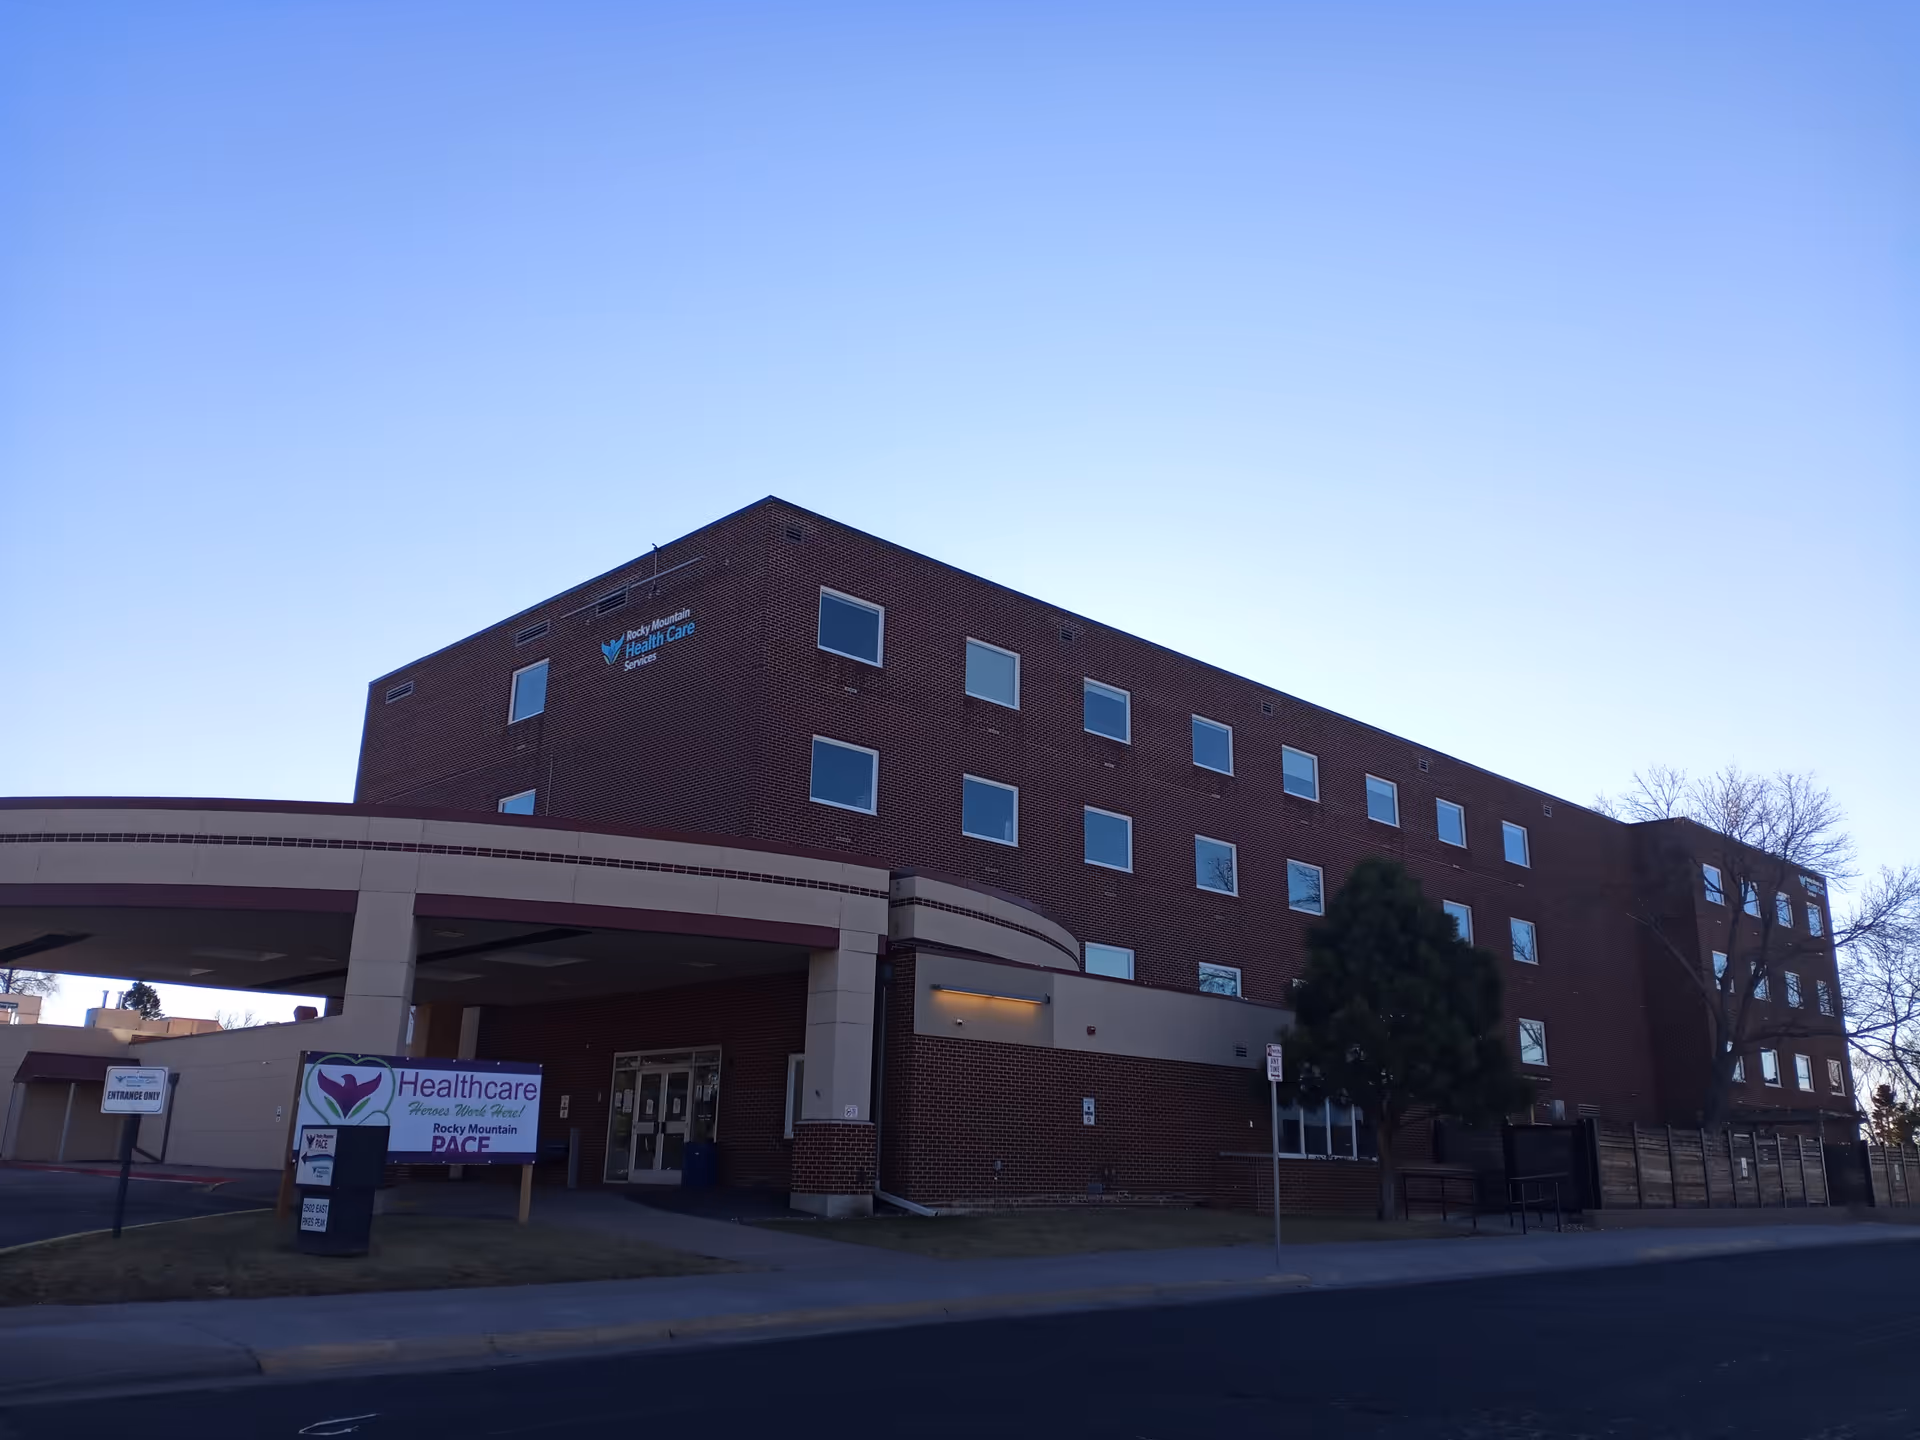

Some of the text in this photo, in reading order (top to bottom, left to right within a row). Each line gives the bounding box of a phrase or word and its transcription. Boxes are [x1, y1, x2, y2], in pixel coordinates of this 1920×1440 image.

[626, 608, 690, 641] Rocky Mountain
[626, 622, 695, 658] Health Care
[624, 653, 657, 671] Services
[398, 1071, 537, 1101] Healthcare
[107, 1090, 161, 1101] ENTRANCE ONLY
[408, 1101, 526, 1118] Heroes Work Here!
[433, 1123, 517, 1135] Rocky Mountain
[315, 1139, 328, 1150] PACE
[431, 1135, 490, 1153] PACE
[315, 1204, 328, 1214] EAST
